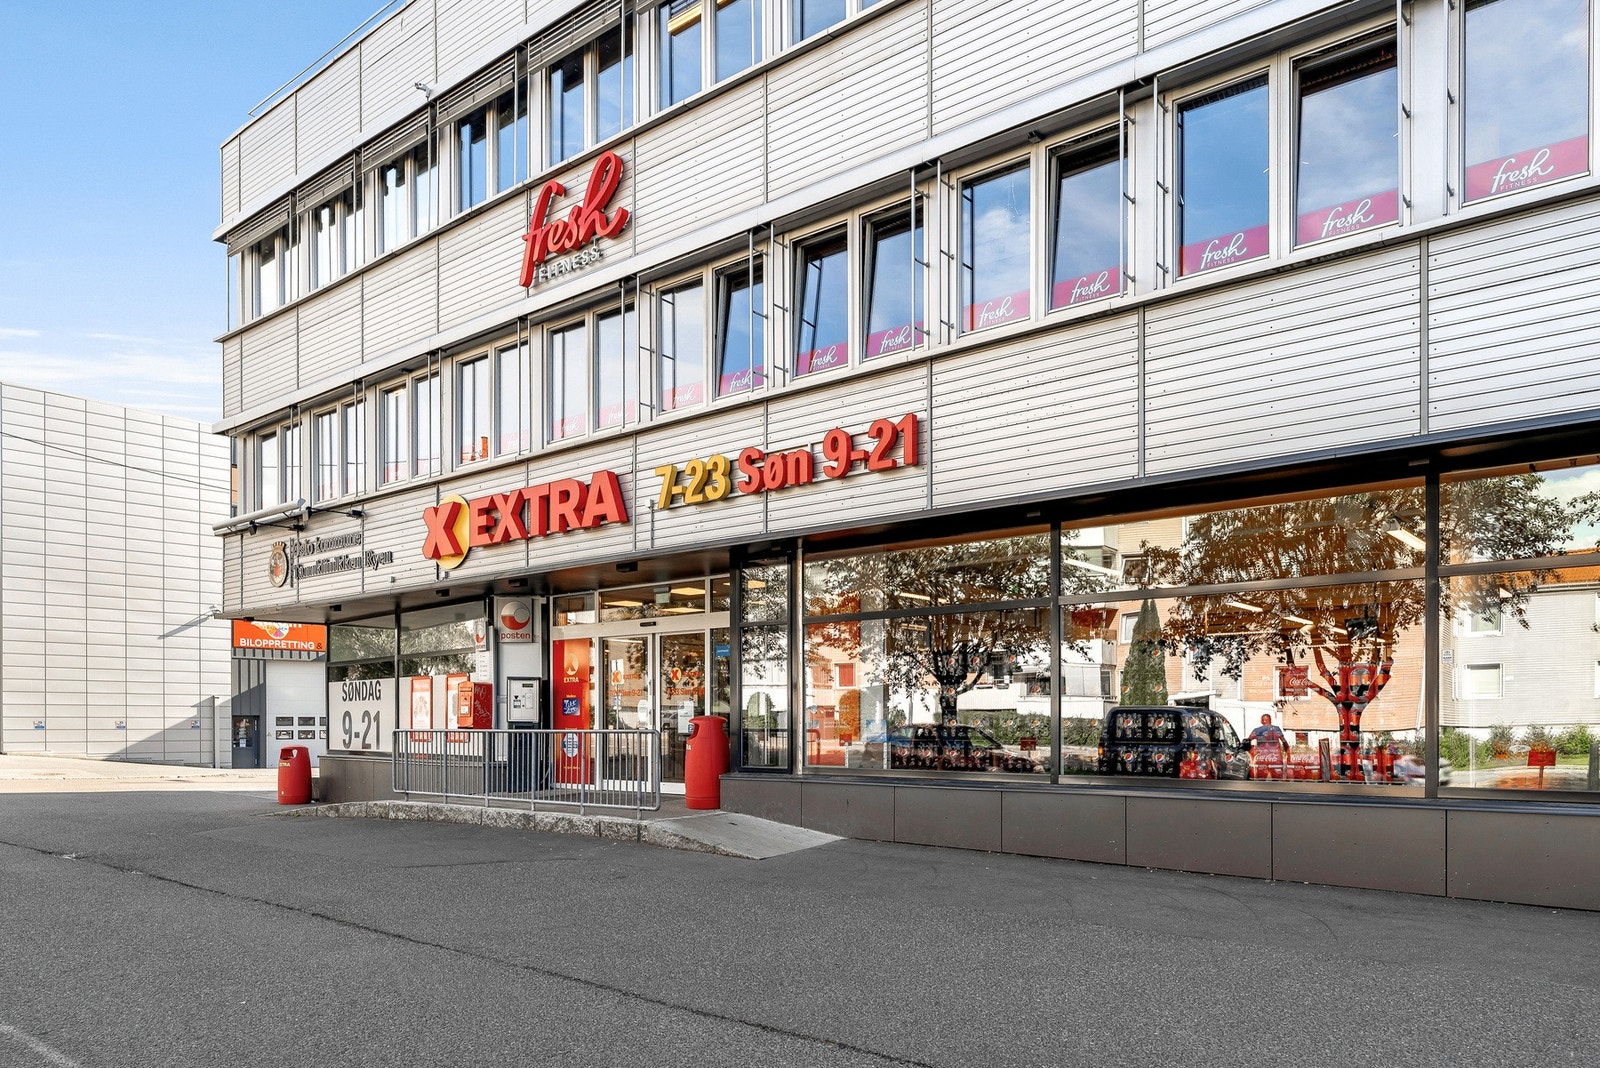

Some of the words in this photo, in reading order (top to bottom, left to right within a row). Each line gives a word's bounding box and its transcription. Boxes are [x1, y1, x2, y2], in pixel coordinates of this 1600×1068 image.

[1491, 148, 1554, 193] fresh
[1500, 177, 1538, 191] FITNESS
[519, 150, 629, 288] fresh
[1321, 199, 1374, 238] fresh
[1329, 224, 1360, 236] FITNESS
[538, 246, 602, 282] FITNESS
[1201, 232, 1247, 269] fresh
[1207, 257, 1235, 268] FITNESS
[1070, 271, 1110, 303] fresh
[979, 296, 1014, 328] fresh
[880, 325, 911, 353] fresh
[809, 345, 838, 372] fresh
[655, 454, 732, 510] 7-23
[738, 446, 813, 494] Søn
[823, 413, 918, 479] 9-21
[470, 470, 628, 547] EXTRA
[364, 549, 394, 570] Ryen
[239, 638, 315, 650] BILOPPRETTING
[500, 632, 531, 640] posten
[342, 680, 381, 702] SØNDAG
[342, 709, 381, 750] 9-21
